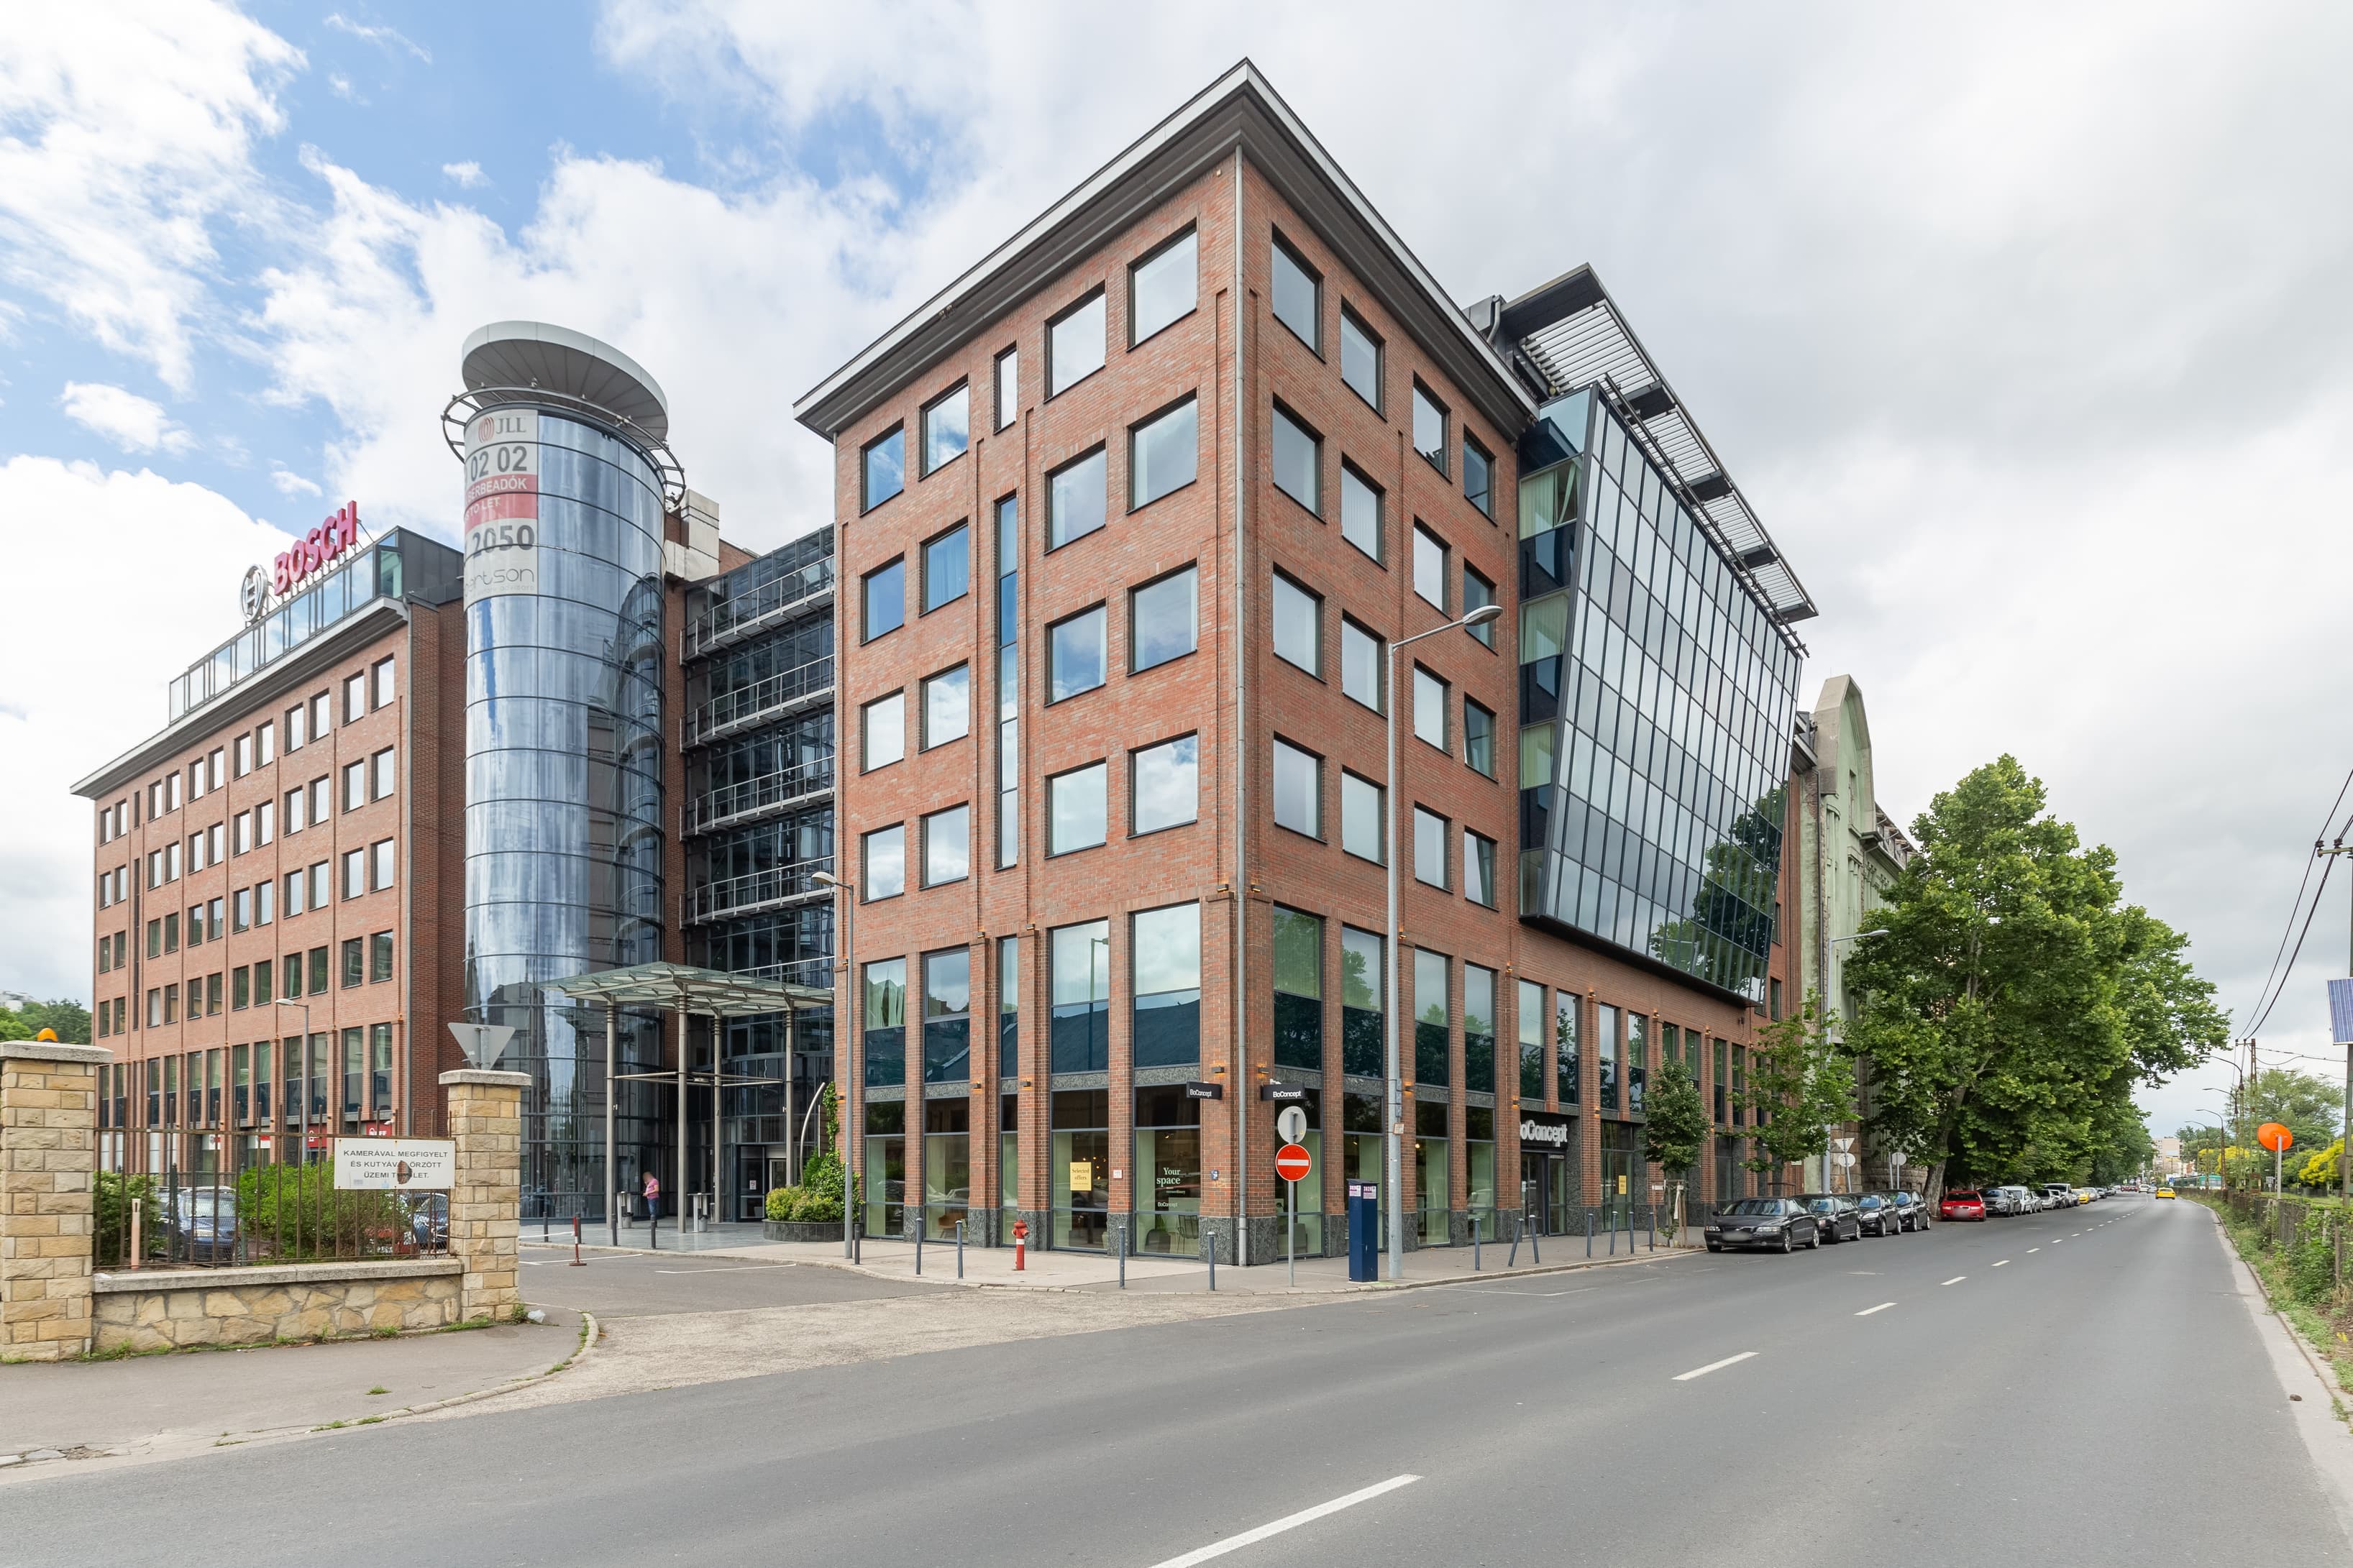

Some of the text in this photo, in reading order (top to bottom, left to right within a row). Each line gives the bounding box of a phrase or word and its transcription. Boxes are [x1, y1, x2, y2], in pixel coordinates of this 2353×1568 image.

[496, 417, 526, 434] JLL
[497, 445, 528, 472] 02
[482, 497, 501, 510] LET
[275, 500, 357, 596] BOSCH
[472, 525, 535, 559] 2050
[1189, 1089, 1212, 1098] BoConcept
[1520, 1119, 1568, 1147] oConcept
[1156, 1178, 1181, 1187] space
